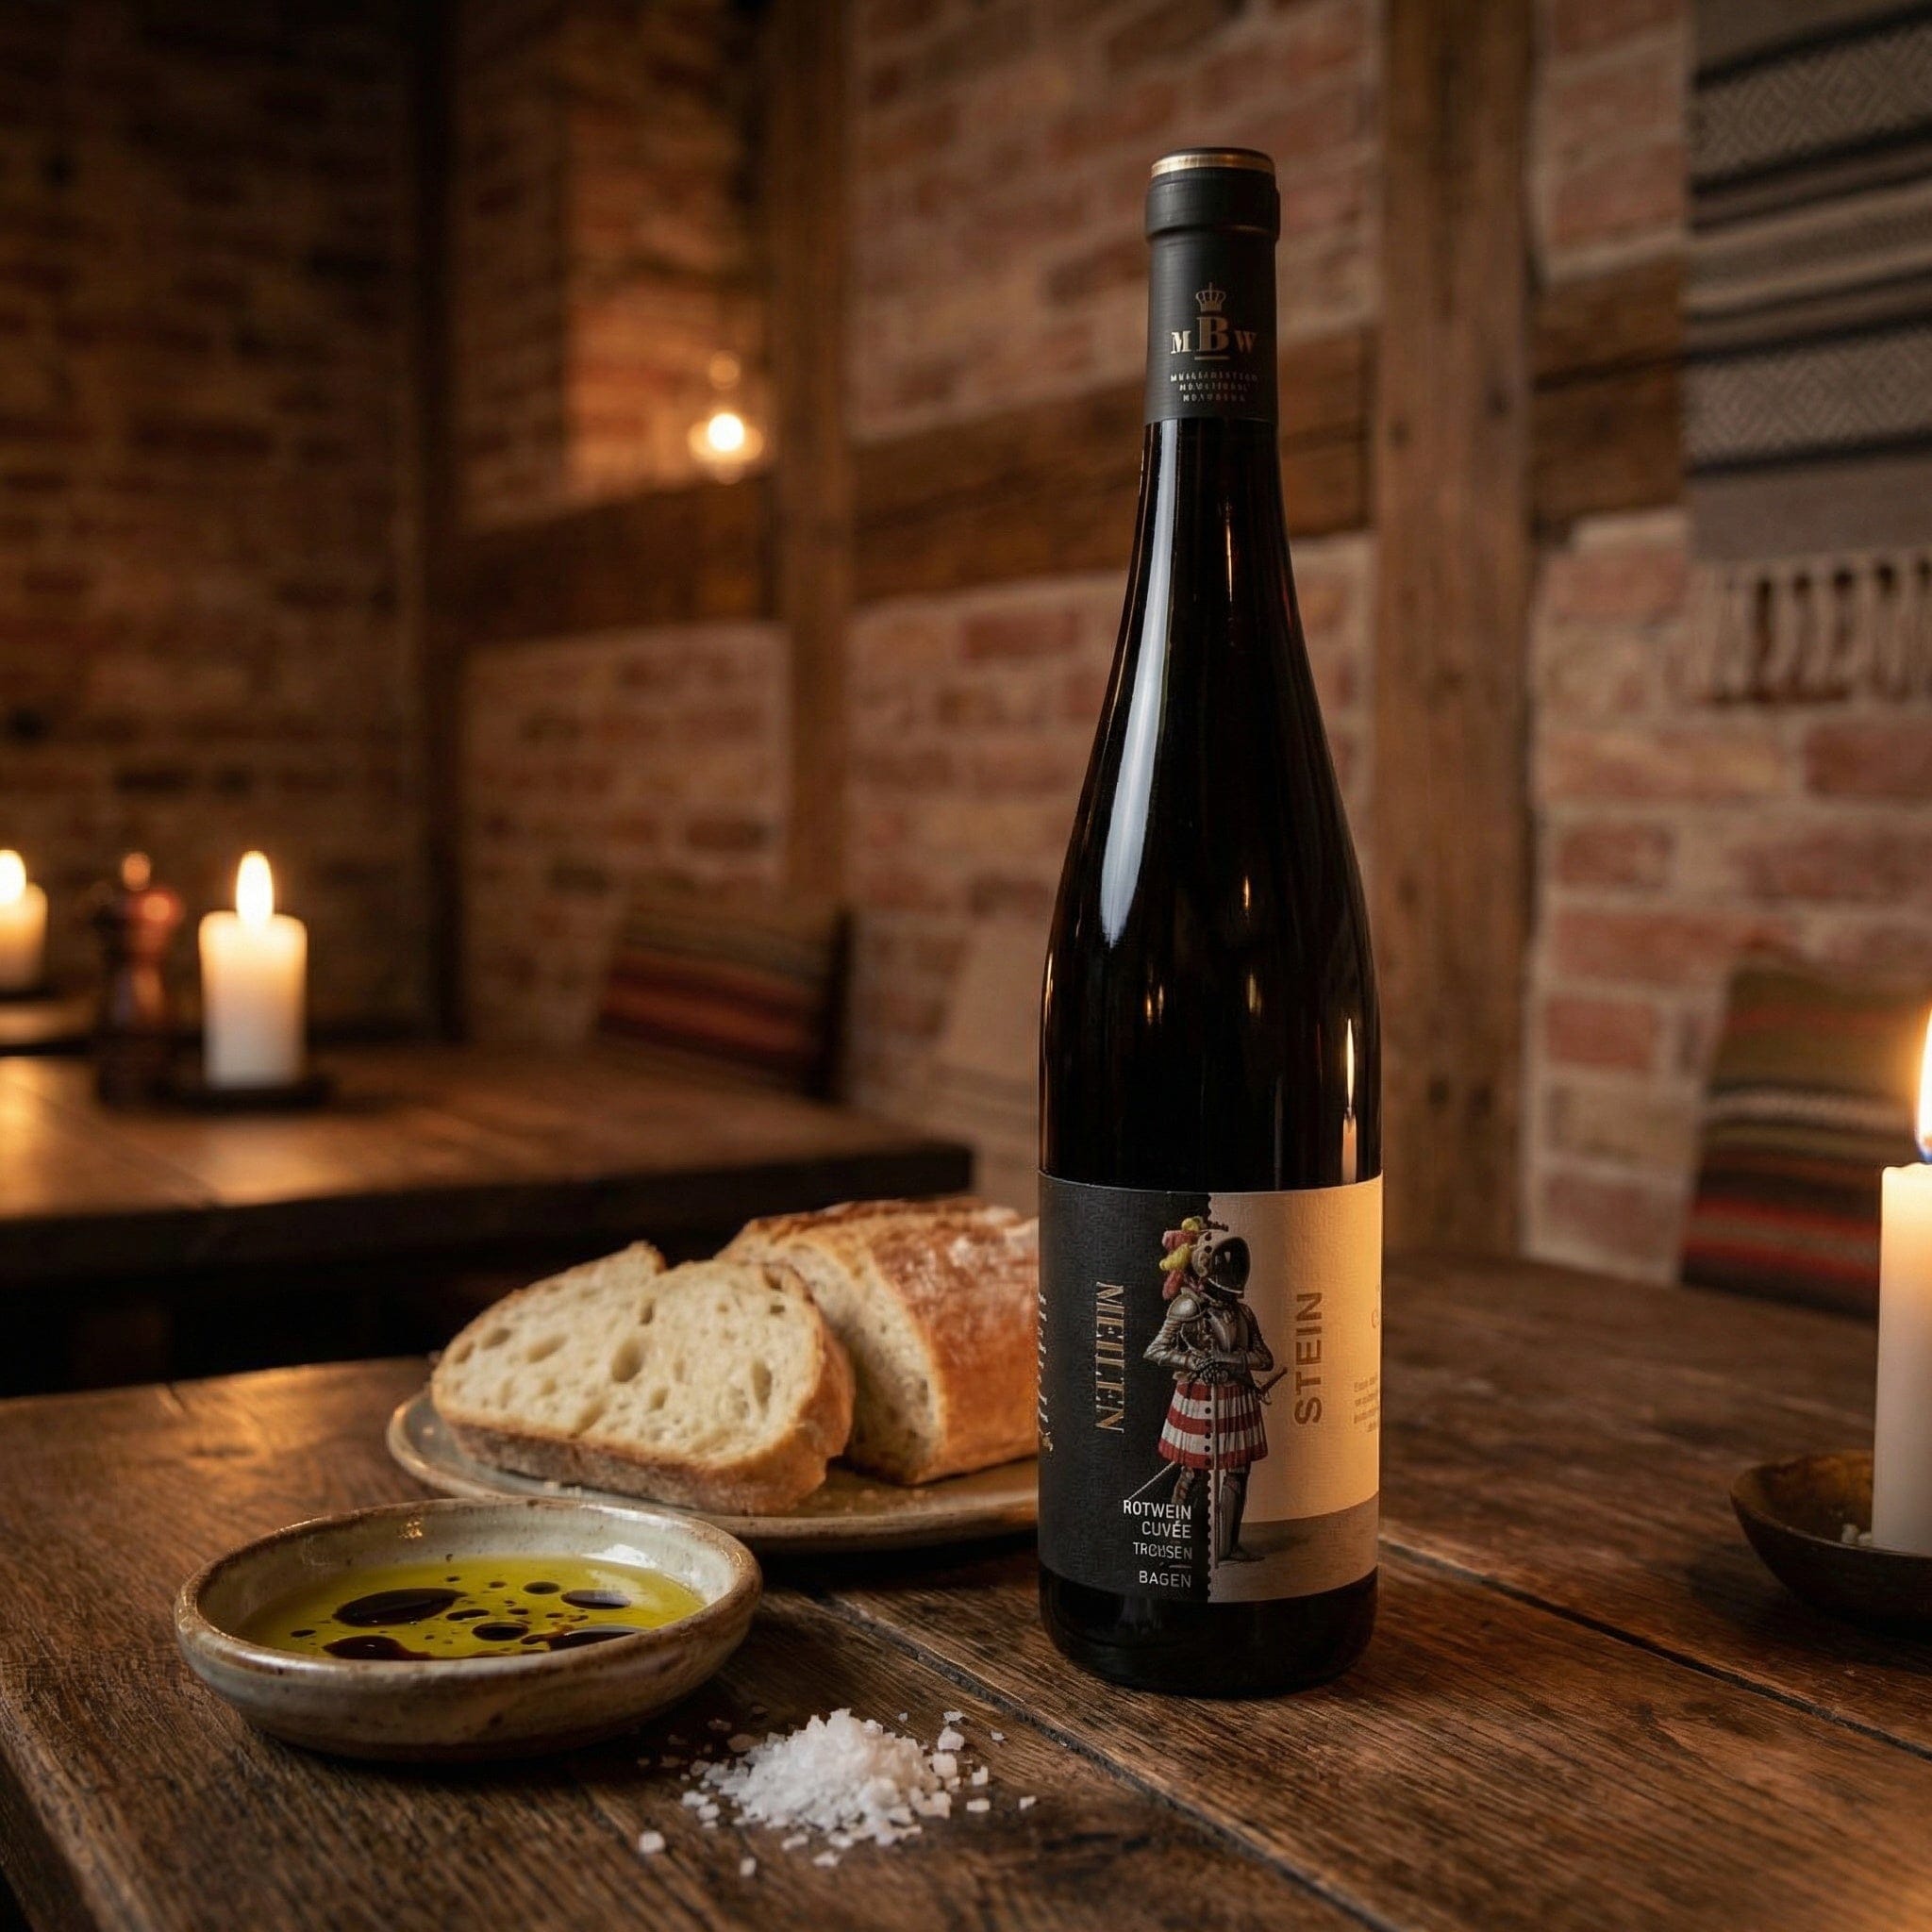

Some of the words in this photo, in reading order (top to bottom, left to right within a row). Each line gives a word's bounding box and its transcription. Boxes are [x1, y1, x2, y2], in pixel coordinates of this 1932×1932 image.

[1294, 1291, 1323, 1424] STEIN
[1123, 1499, 1191, 1520] ROTWEIN
[1141, 1520, 1191, 1539] CUVÉE
[1139, 1570, 1191, 1588] BAGEN
